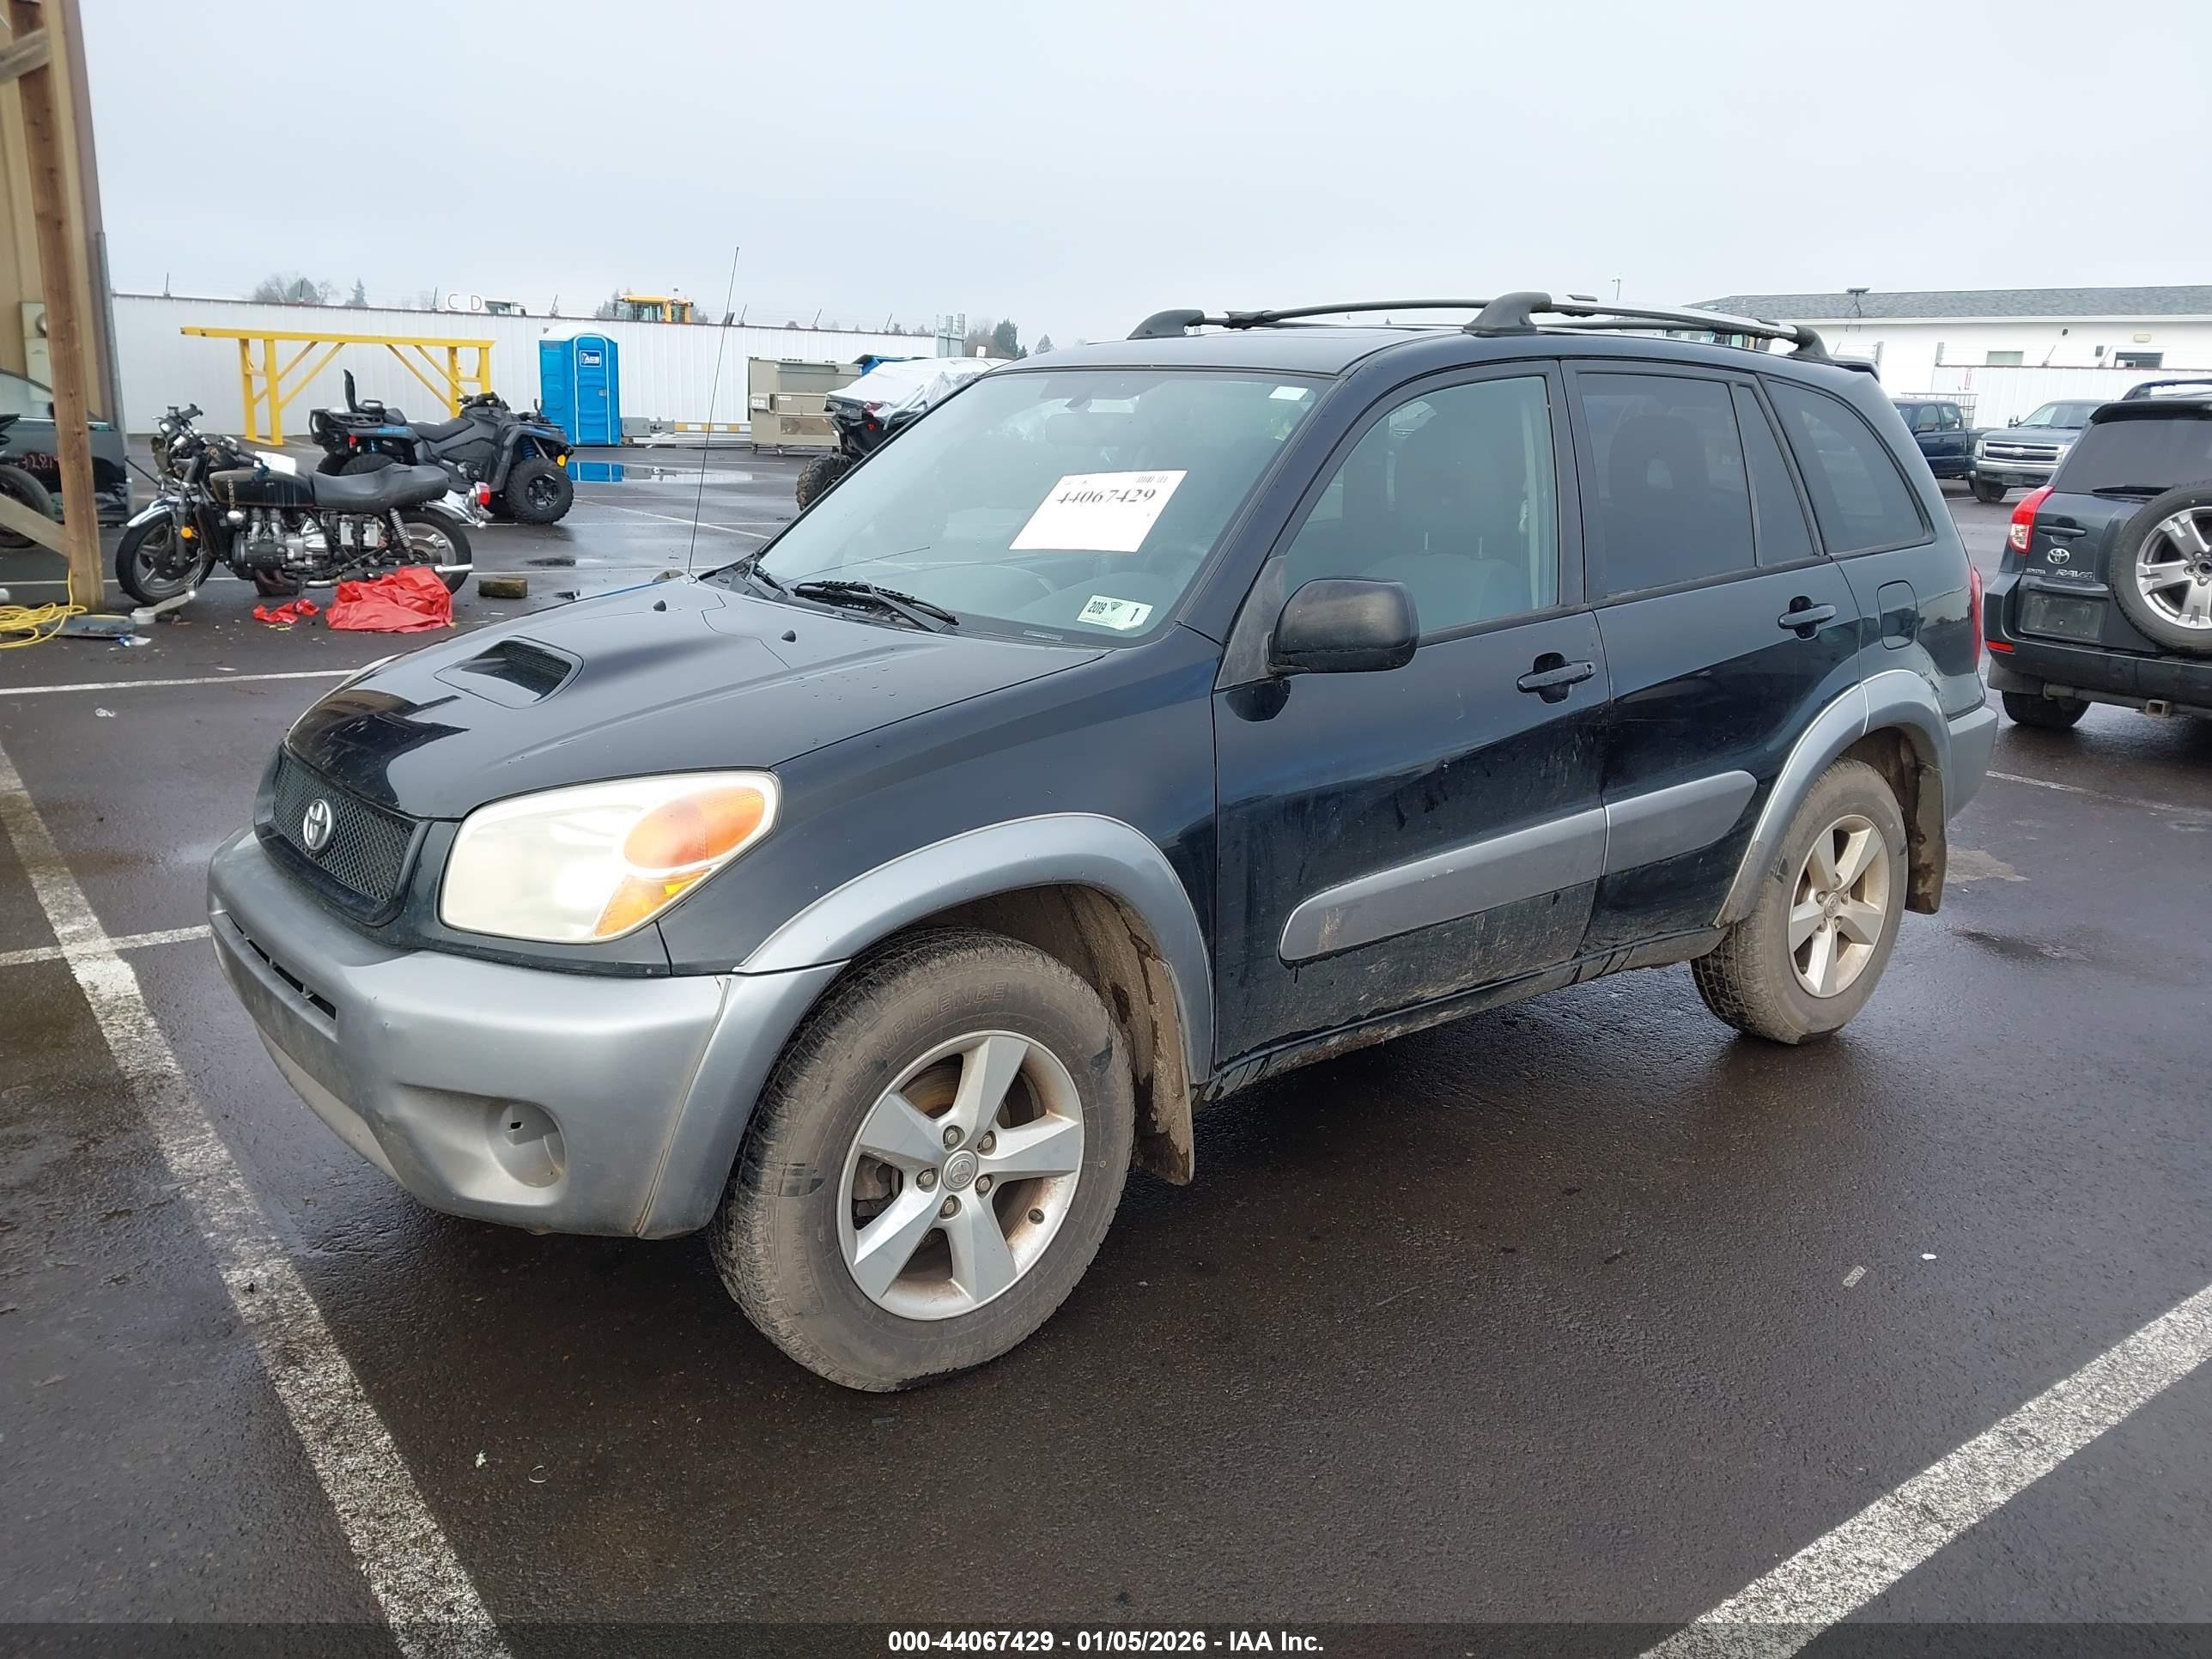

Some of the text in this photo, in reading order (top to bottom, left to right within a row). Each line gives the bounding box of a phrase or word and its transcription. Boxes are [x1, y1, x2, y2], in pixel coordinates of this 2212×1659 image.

[447, 294, 483, 311] C D
[1056, 488, 1157, 505] 44067429
[1087, 600, 1140, 623] 2019 1
